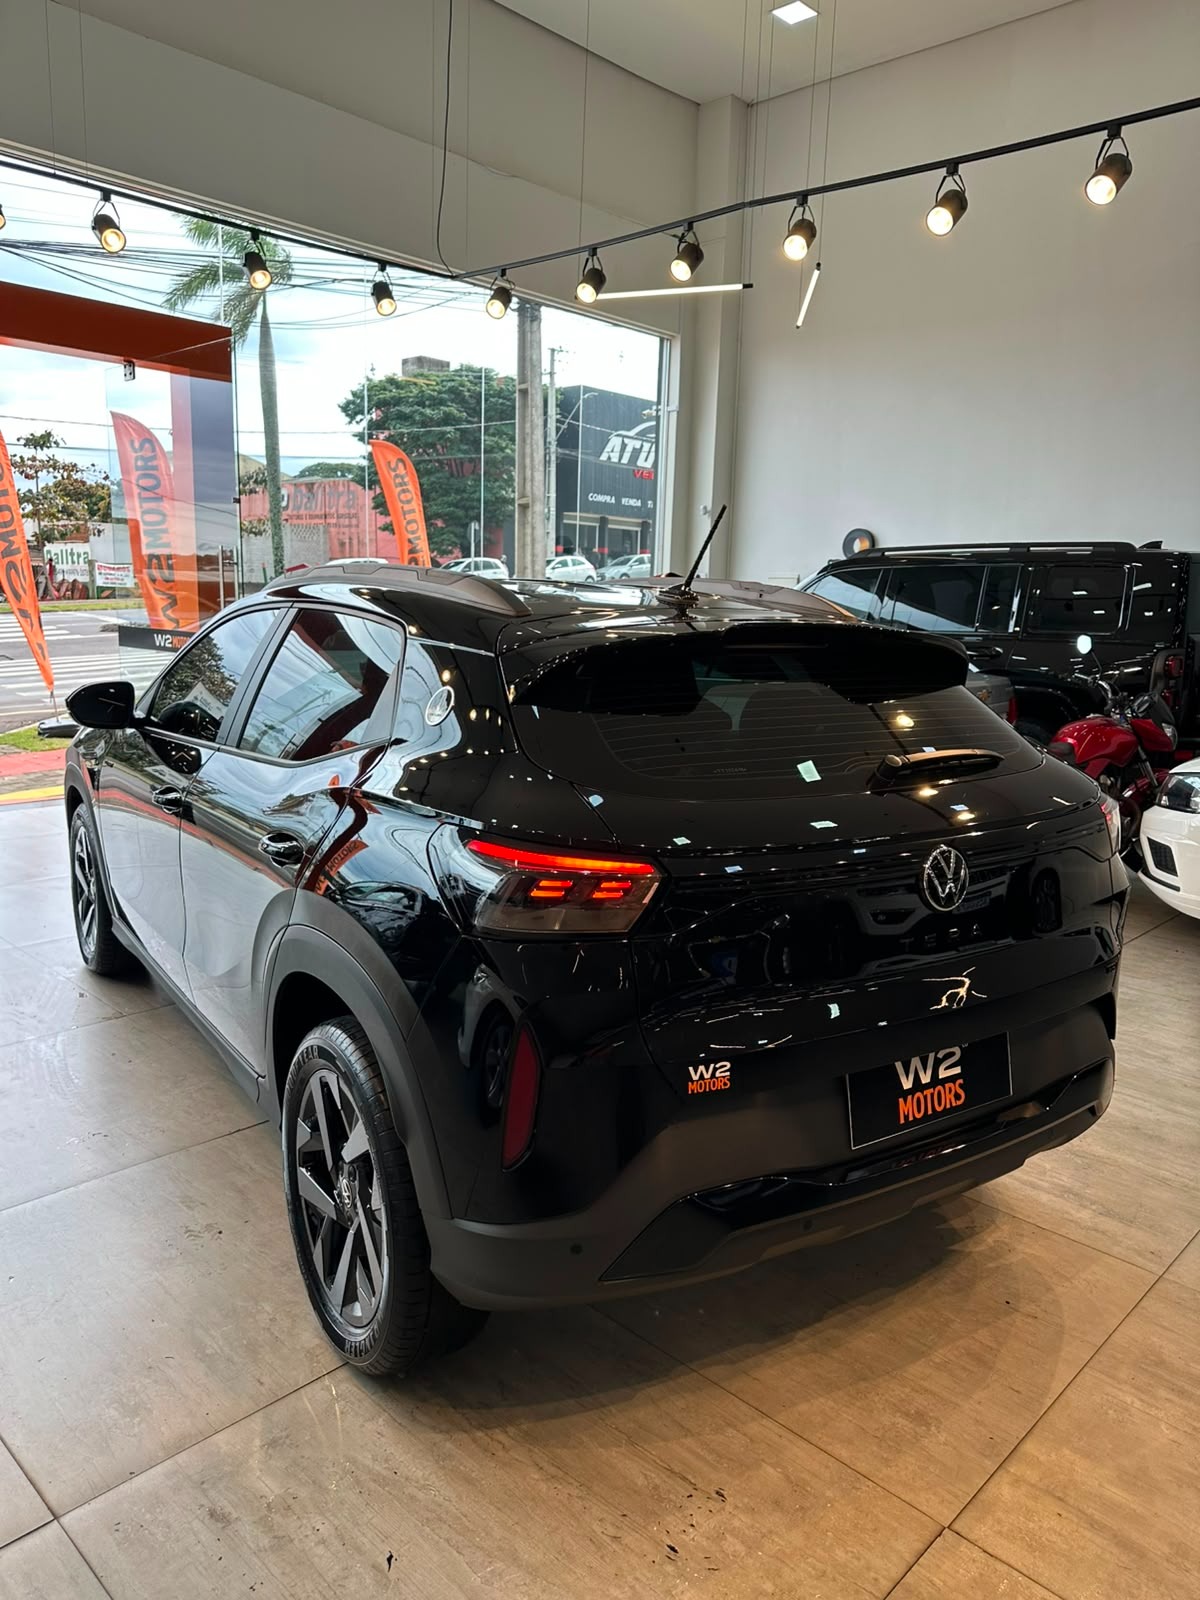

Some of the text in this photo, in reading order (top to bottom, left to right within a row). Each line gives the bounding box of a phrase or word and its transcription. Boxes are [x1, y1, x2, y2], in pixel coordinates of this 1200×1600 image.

[129, 437, 172, 551] MOTORS
[387, 457, 424, 554] MOTORS
[588, 493, 615, 504] COMPRA
[621, 497, 642, 507] VENDA
[154, 633, 173, 648] W2
[687, 1061, 732, 1081] W2
[894, 1045, 962, 1091] W2
[687, 1076, 731, 1095] MOTORS
[898, 1078, 966, 1125] MOTORS
